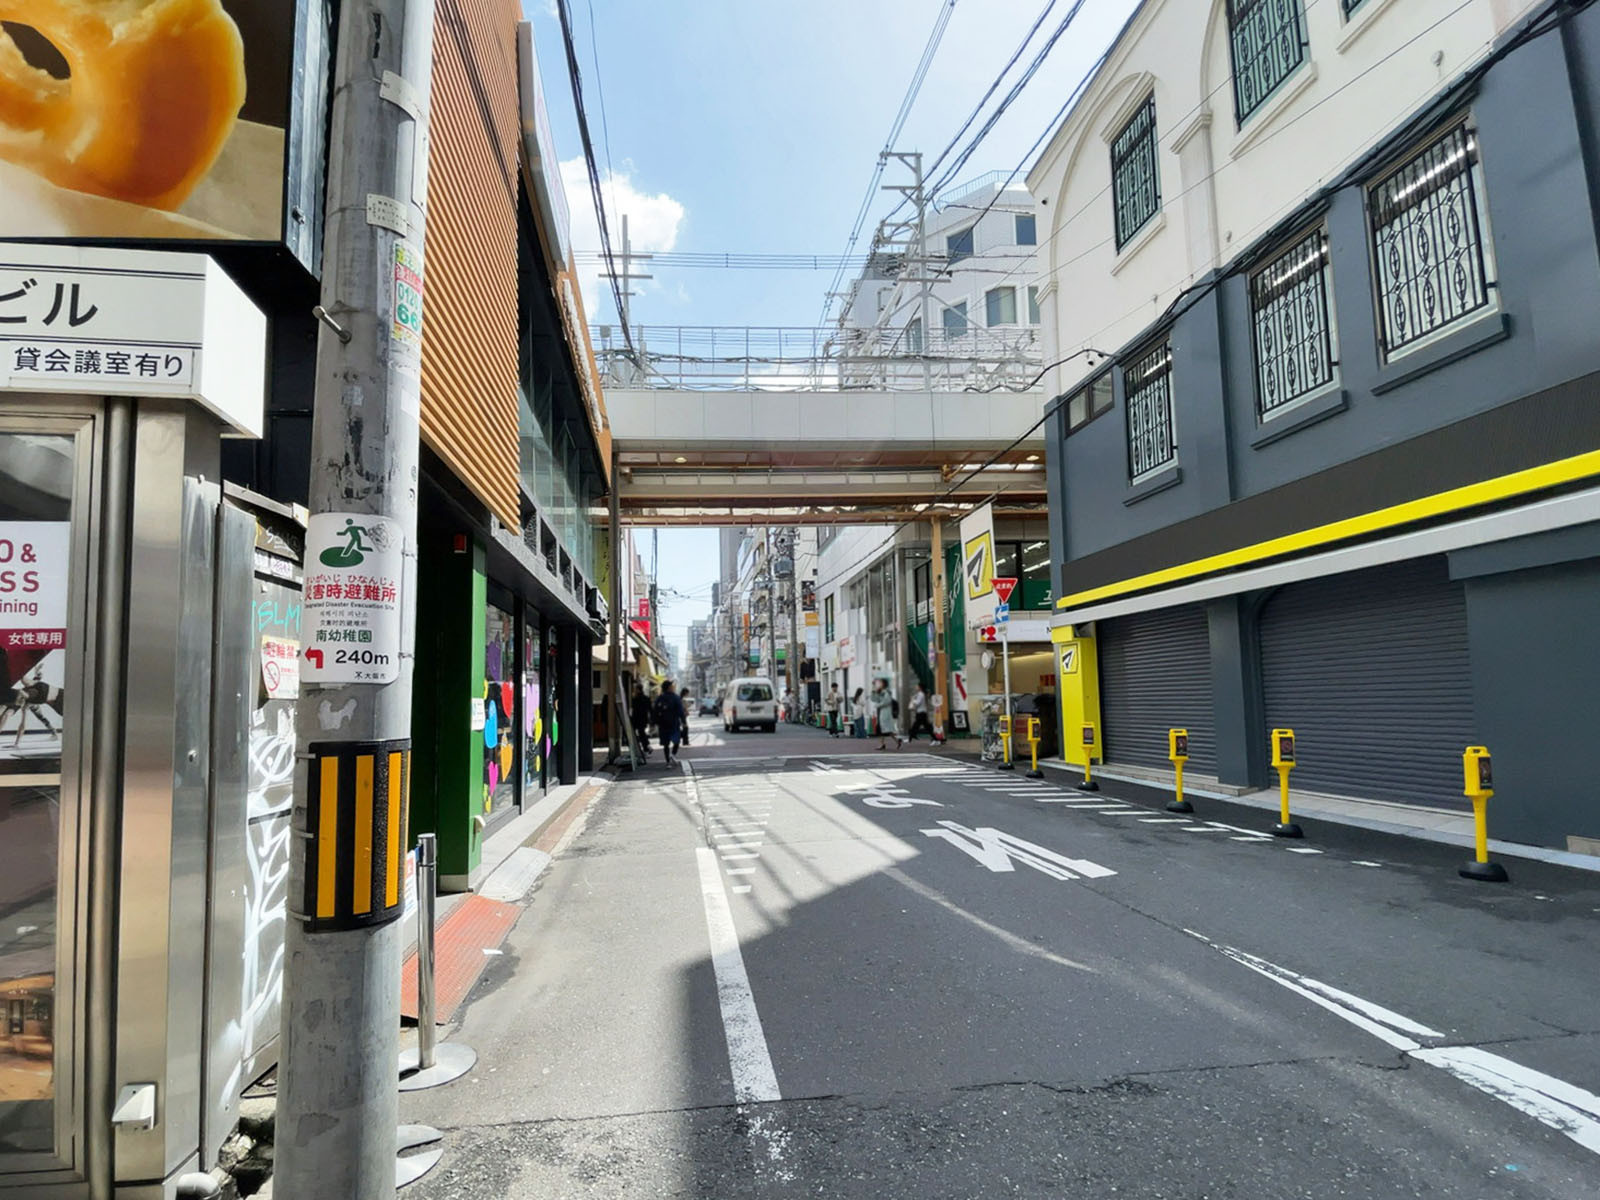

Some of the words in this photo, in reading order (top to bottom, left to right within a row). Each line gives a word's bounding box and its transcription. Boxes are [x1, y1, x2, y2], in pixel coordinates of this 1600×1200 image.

[14, 346, 183, 377] 貸会議室有り
[20, 543, 37, 563] &
[305, 584, 397, 603] 災害時避難所
[350, 602, 383, 610] Evacuation
[8, 632, 63, 646] 女性専用
[315, 629, 373, 643] 南幼稚園
[335, 649, 389, 665] 240m
